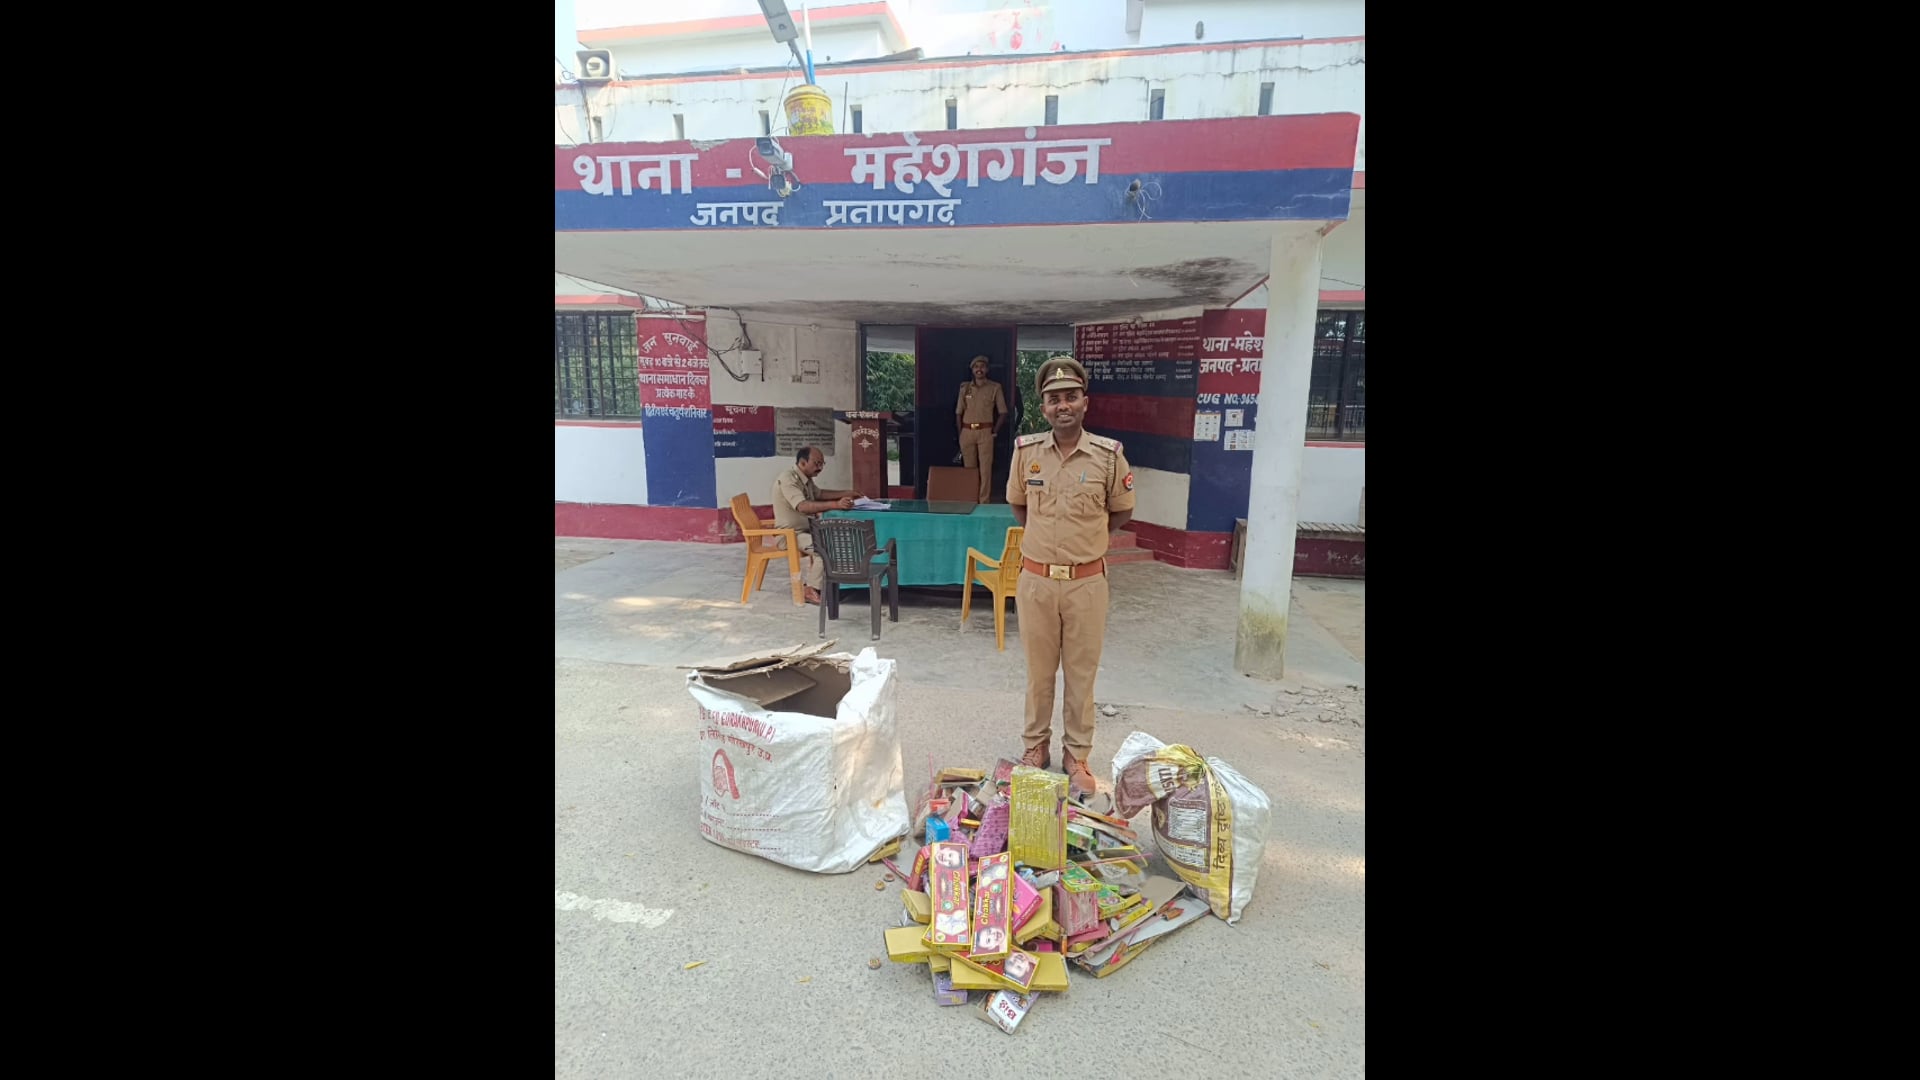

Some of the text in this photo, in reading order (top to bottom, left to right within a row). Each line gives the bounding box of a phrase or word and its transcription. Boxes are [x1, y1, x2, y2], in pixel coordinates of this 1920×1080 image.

[573, 153, 699, 196] थाना
[843, 126, 1112, 198] महेशगंज
[689, 201, 785, 226] जनपद
[1196, 393, 1221, 405] CUG
